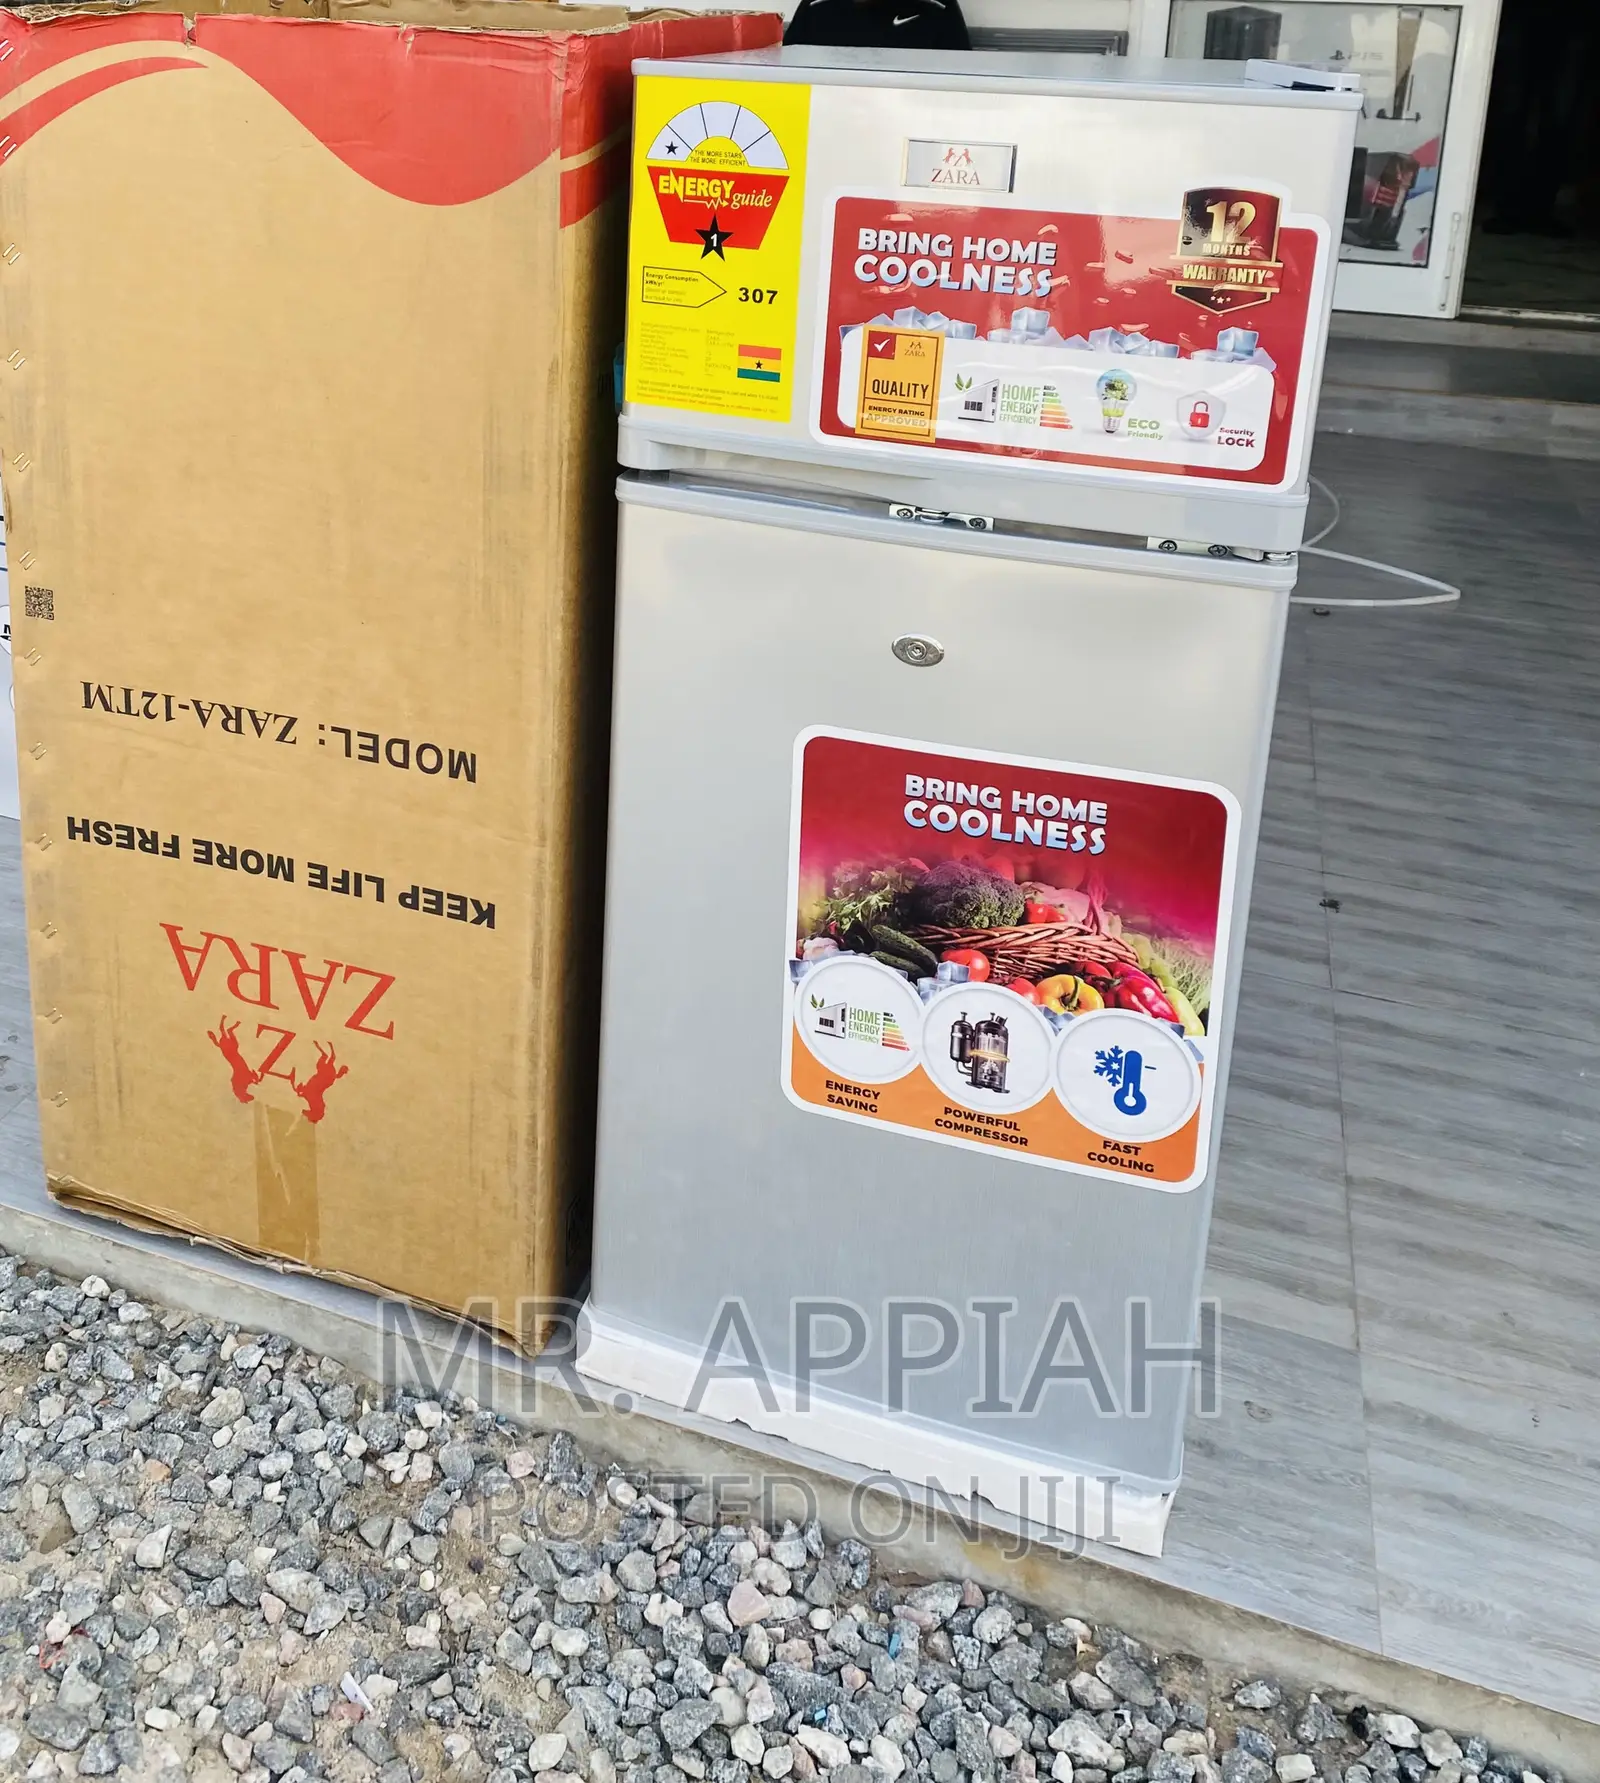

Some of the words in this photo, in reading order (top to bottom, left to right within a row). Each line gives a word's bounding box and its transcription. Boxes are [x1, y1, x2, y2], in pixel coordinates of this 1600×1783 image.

[701, 157, 717, 165] MORE
[719, 158, 746, 167] EFFICIENT
[706, 150, 722, 158] MORE
[724, 151, 742, 159] STARS
[931, 167, 981, 186] ZARA
[658, 169, 735, 203] ENERGY
[730, 189, 773, 210] guide
[1206, 200, 1257, 245] 12
[710, 233, 719, 248] 1
[857, 226, 954, 258] BRING
[961, 236, 1058, 266] HOME
[1201, 242, 1252, 257] MONTHS
[645, 271, 664, 281] Energy
[664, 273, 699, 284] Consumption
[853, 253, 1053, 298] COOLNESS
[1182, 263, 1268, 285] WARRANTY
[737, 286, 779, 305] 307
[904, 348, 926, 358] ZARA
[871, 378, 930, 401] QUALITY
[1001, 383, 1041, 403] HOME
[867, 405, 897, 415] ENERGY
[898, 408, 926, 417] RATING
[1000, 400, 1039, 415] ENERGY
[865, 412, 927, 428] APPROVED
[999, 412, 1038, 425] EFFICIENCY
[1127, 417, 1161, 431] ECO
[1127, 429, 1164, 441] Friendly
[1217, 436, 1256, 449] LOCK
[1219, 427, 1255, 438] Security
[80, 680, 299, 745] ZARA-12TM
[318, 722, 478, 784] MODEL:
[904, 773, 1003, 812] BRING
[1010, 790, 1108, 826] HOME
[66, 816, 181, 860] FRESH
[902, 799, 1107, 856] COOLNESS
[192, 838, 295, 884] MORE
[306, 861, 386, 903] LIFE
[397, 884, 497, 930] KEEP
[159, 922, 396, 1041] ZARA
[848, 1006, 882, 1027] HOME
[847, 1030, 881, 1045] EFFICIENCY
[848, 1020, 881, 1036] ENERGY
[824, 1079, 881, 1100] ENERGY
[825, 1092, 879, 1114] SAVING
[943, 1105, 1022, 1133] POWERFUL
[933, 1117, 1029, 1148] COMPRESSOR
[1102, 1139, 1142, 1157] FAST
[1086, 1150, 1155, 1174] COOLING
